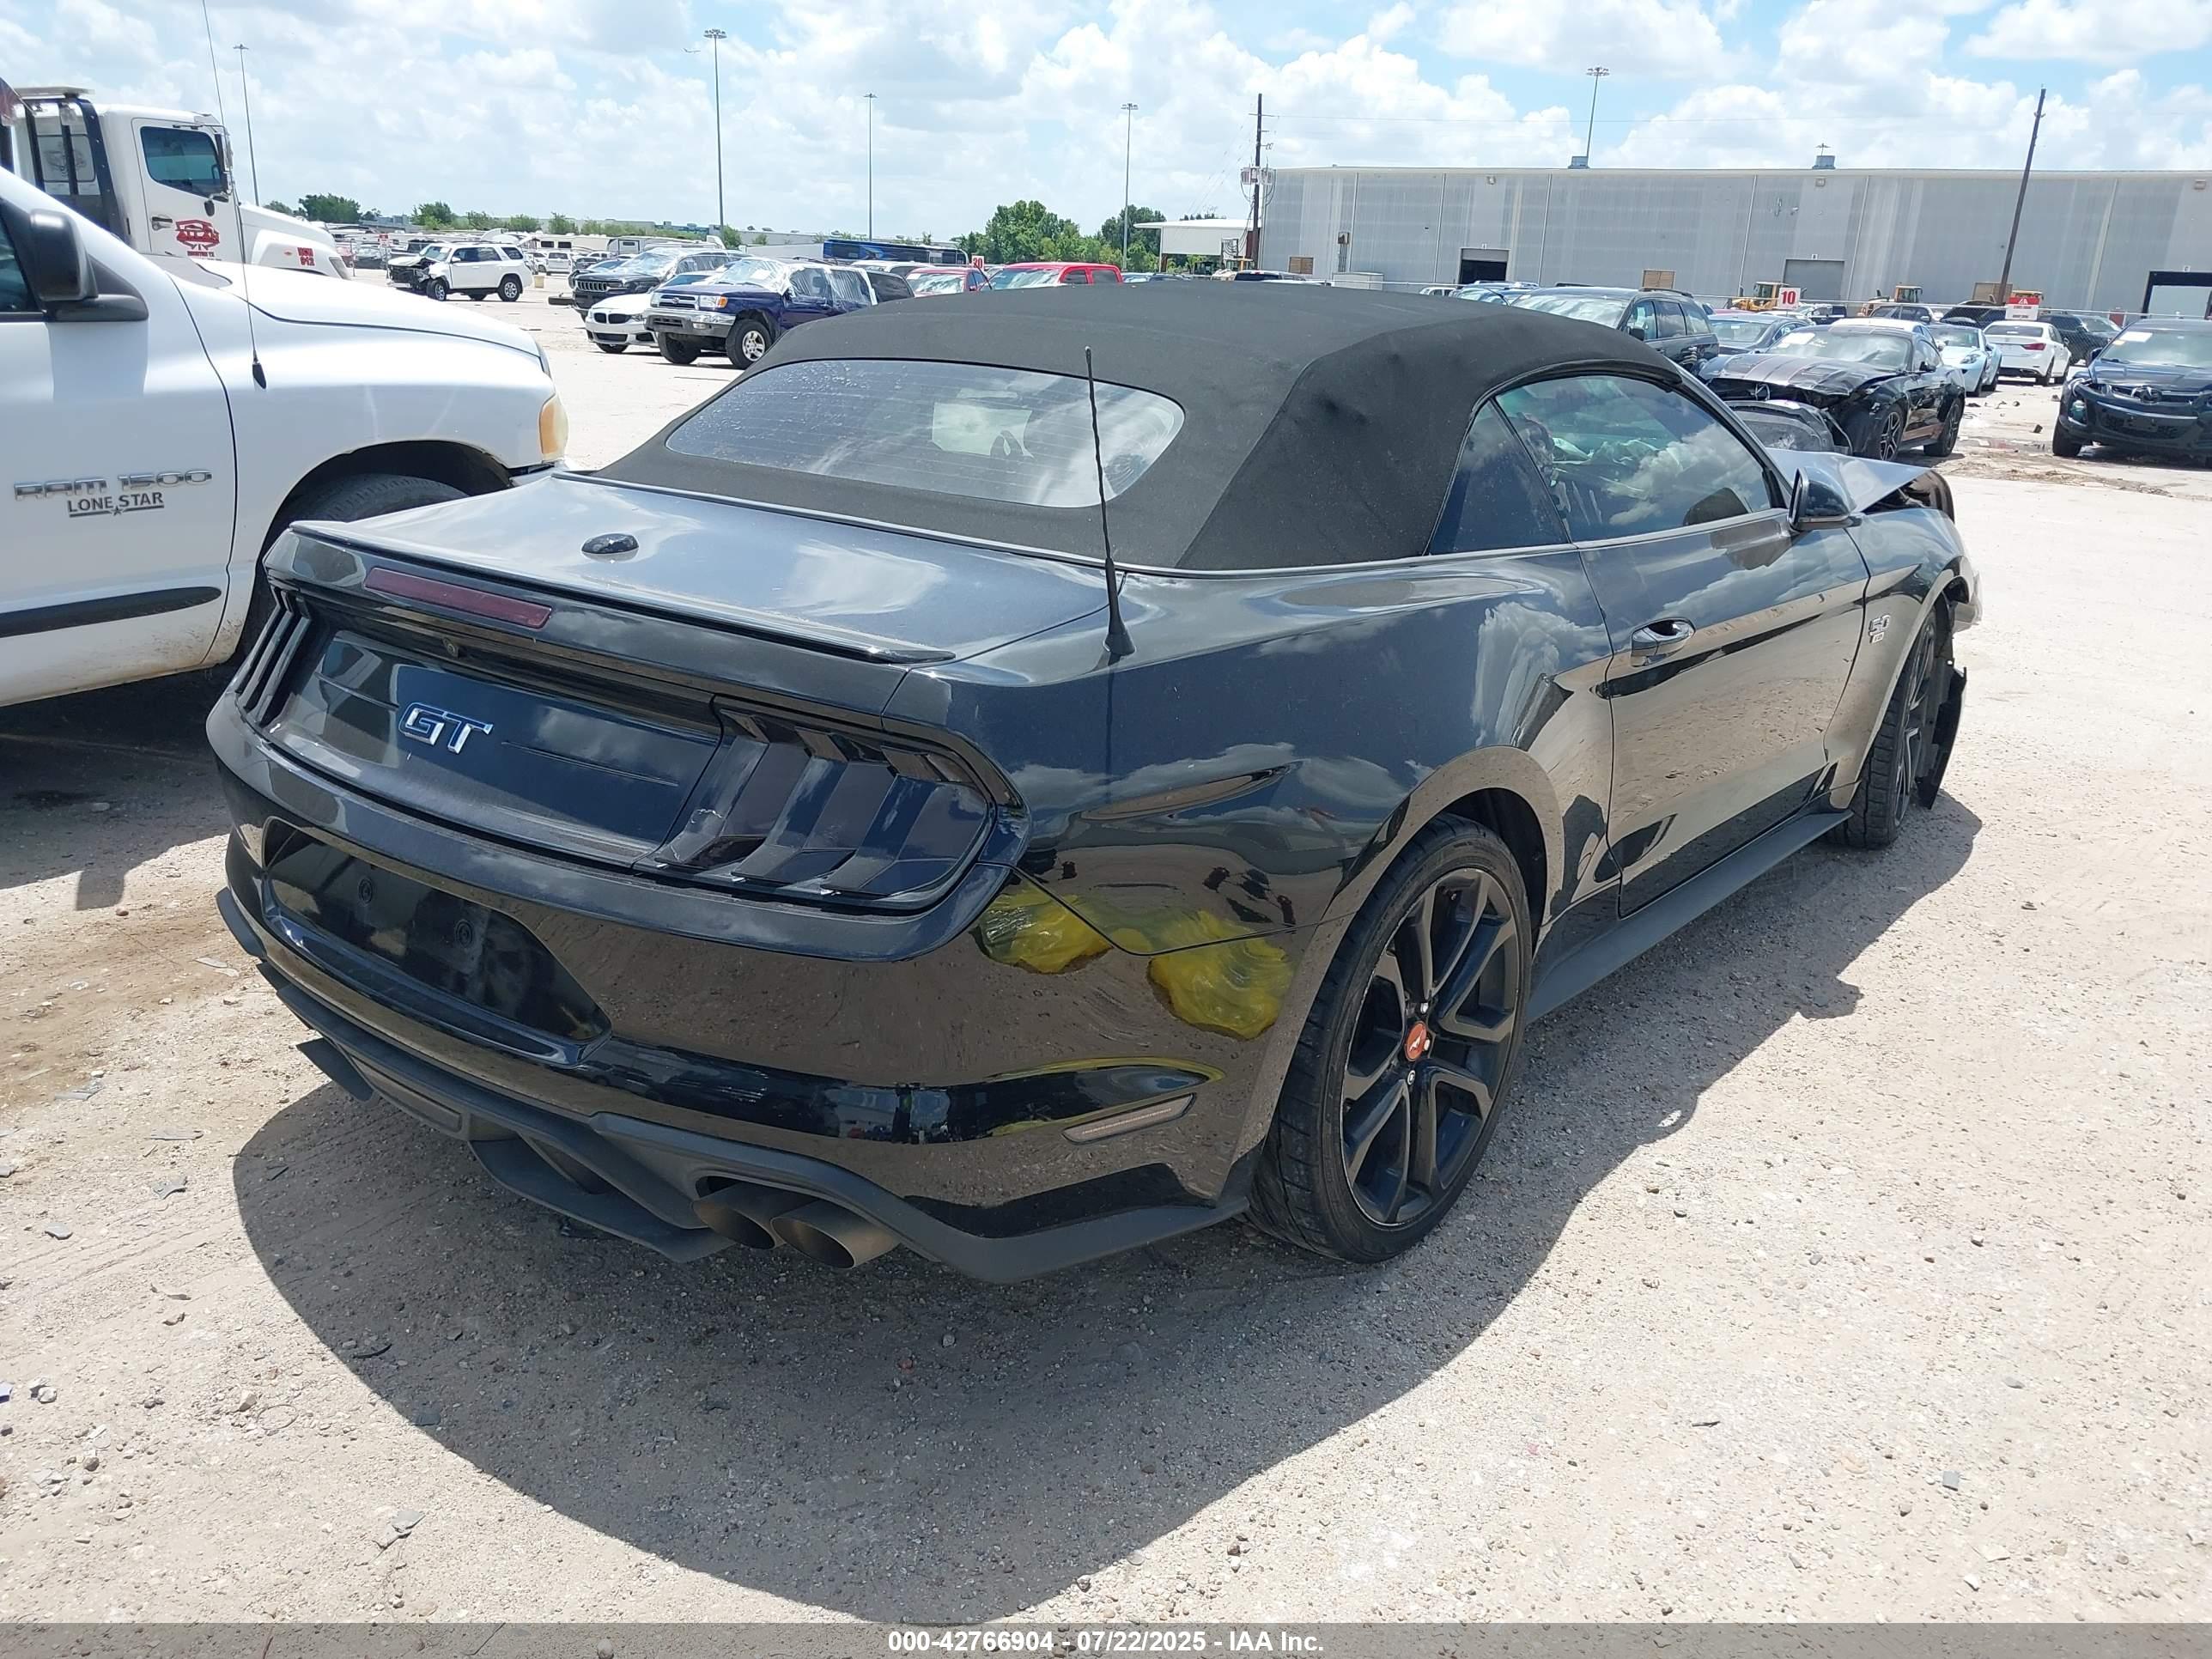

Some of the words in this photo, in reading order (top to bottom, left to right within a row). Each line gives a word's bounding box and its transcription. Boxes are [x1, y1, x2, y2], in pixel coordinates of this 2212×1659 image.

[1781, 290, 1796, 305] 10
[14, 478, 108, 501] RAM
[118, 469, 213, 490] 1500
[67, 495, 114, 513] LONE
[118, 491, 165, 507] STAR
[398, 702, 494, 755] GT
